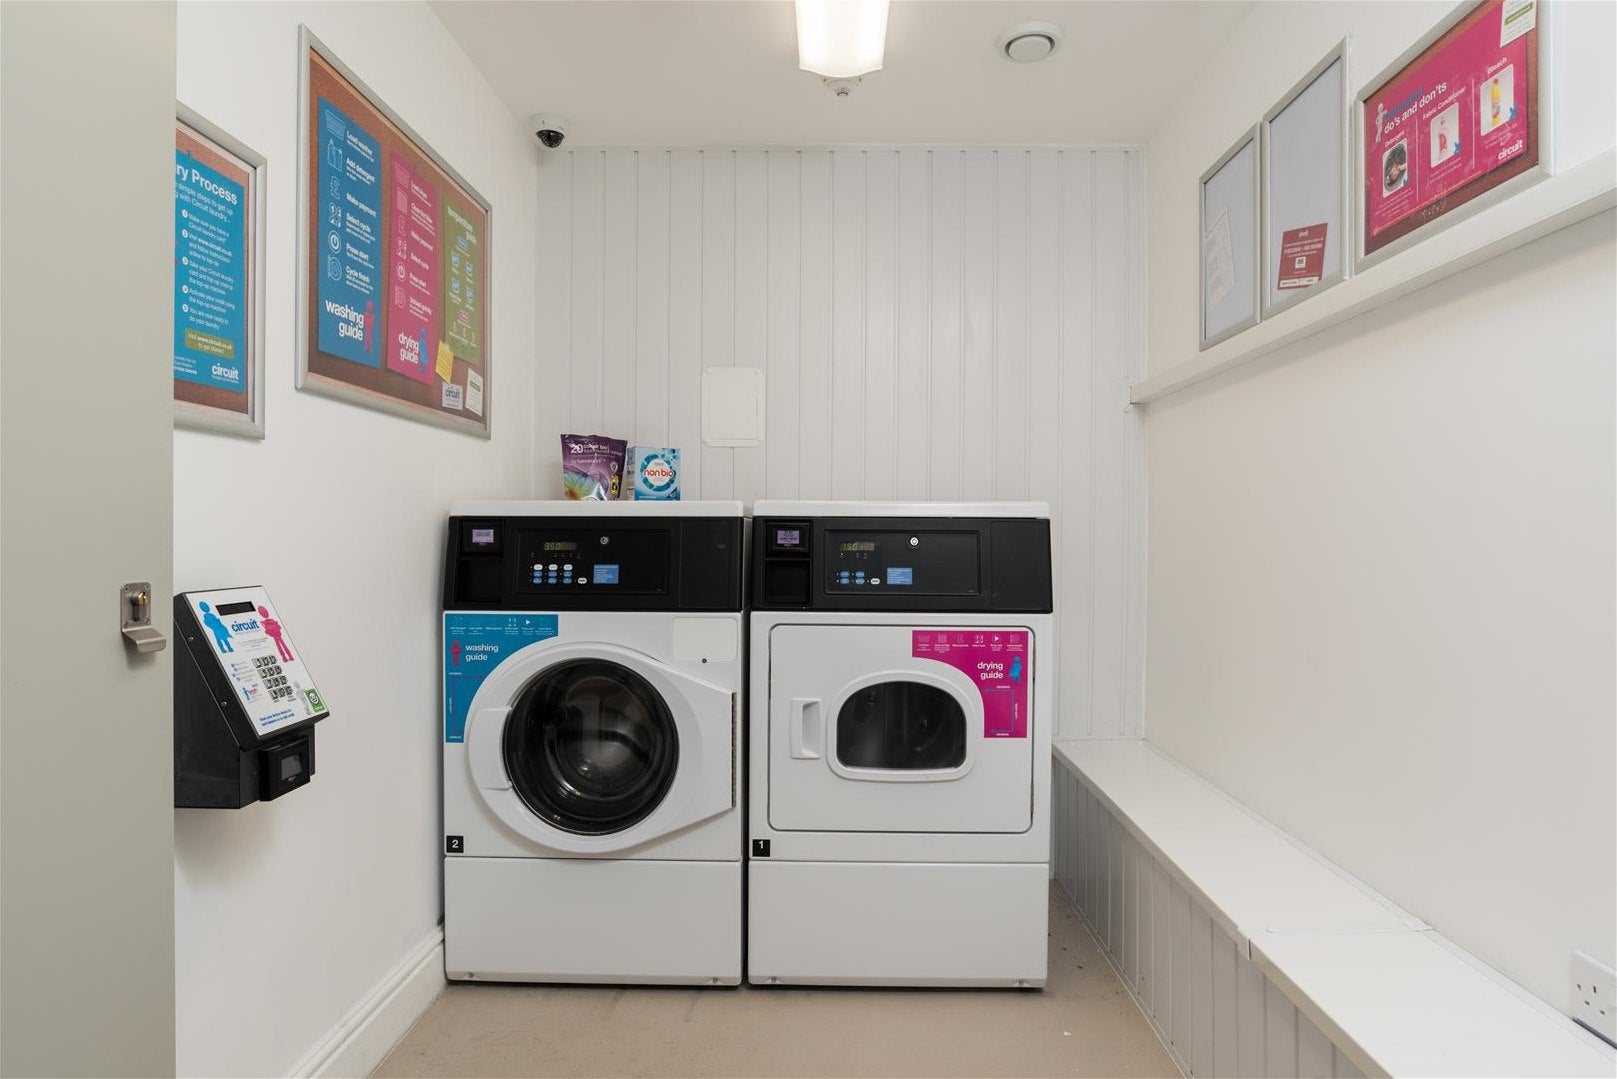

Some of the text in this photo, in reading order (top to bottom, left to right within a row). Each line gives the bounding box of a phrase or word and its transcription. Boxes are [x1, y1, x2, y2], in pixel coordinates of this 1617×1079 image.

[1384, 115, 1401, 134] do's
[1402, 101, 1418, 121] and
[1419, 82, 1447, 109] don'ts
[1498, 140, 1524, 161] circuit
[192, 168, 238, 205] Process
[325, 299, 364, 329] washing
[339, 321, 363, 341] guide
[398, 331, 420, 353] drying
[399, 348, 419, 364] guide
[211, 362, 239, 380] circuit
[570, 443, 583, 454] 20
[231, 618, 260, 632] circuit
[465, 643, 499, 653] washing
[465, 652, 488, 662] guide
[977, 661, 1004, 671] drying
[980, 671, 1004, 680] guide
[452, 839, 459, 848] 2
[758, 840, 764, 849] 1
